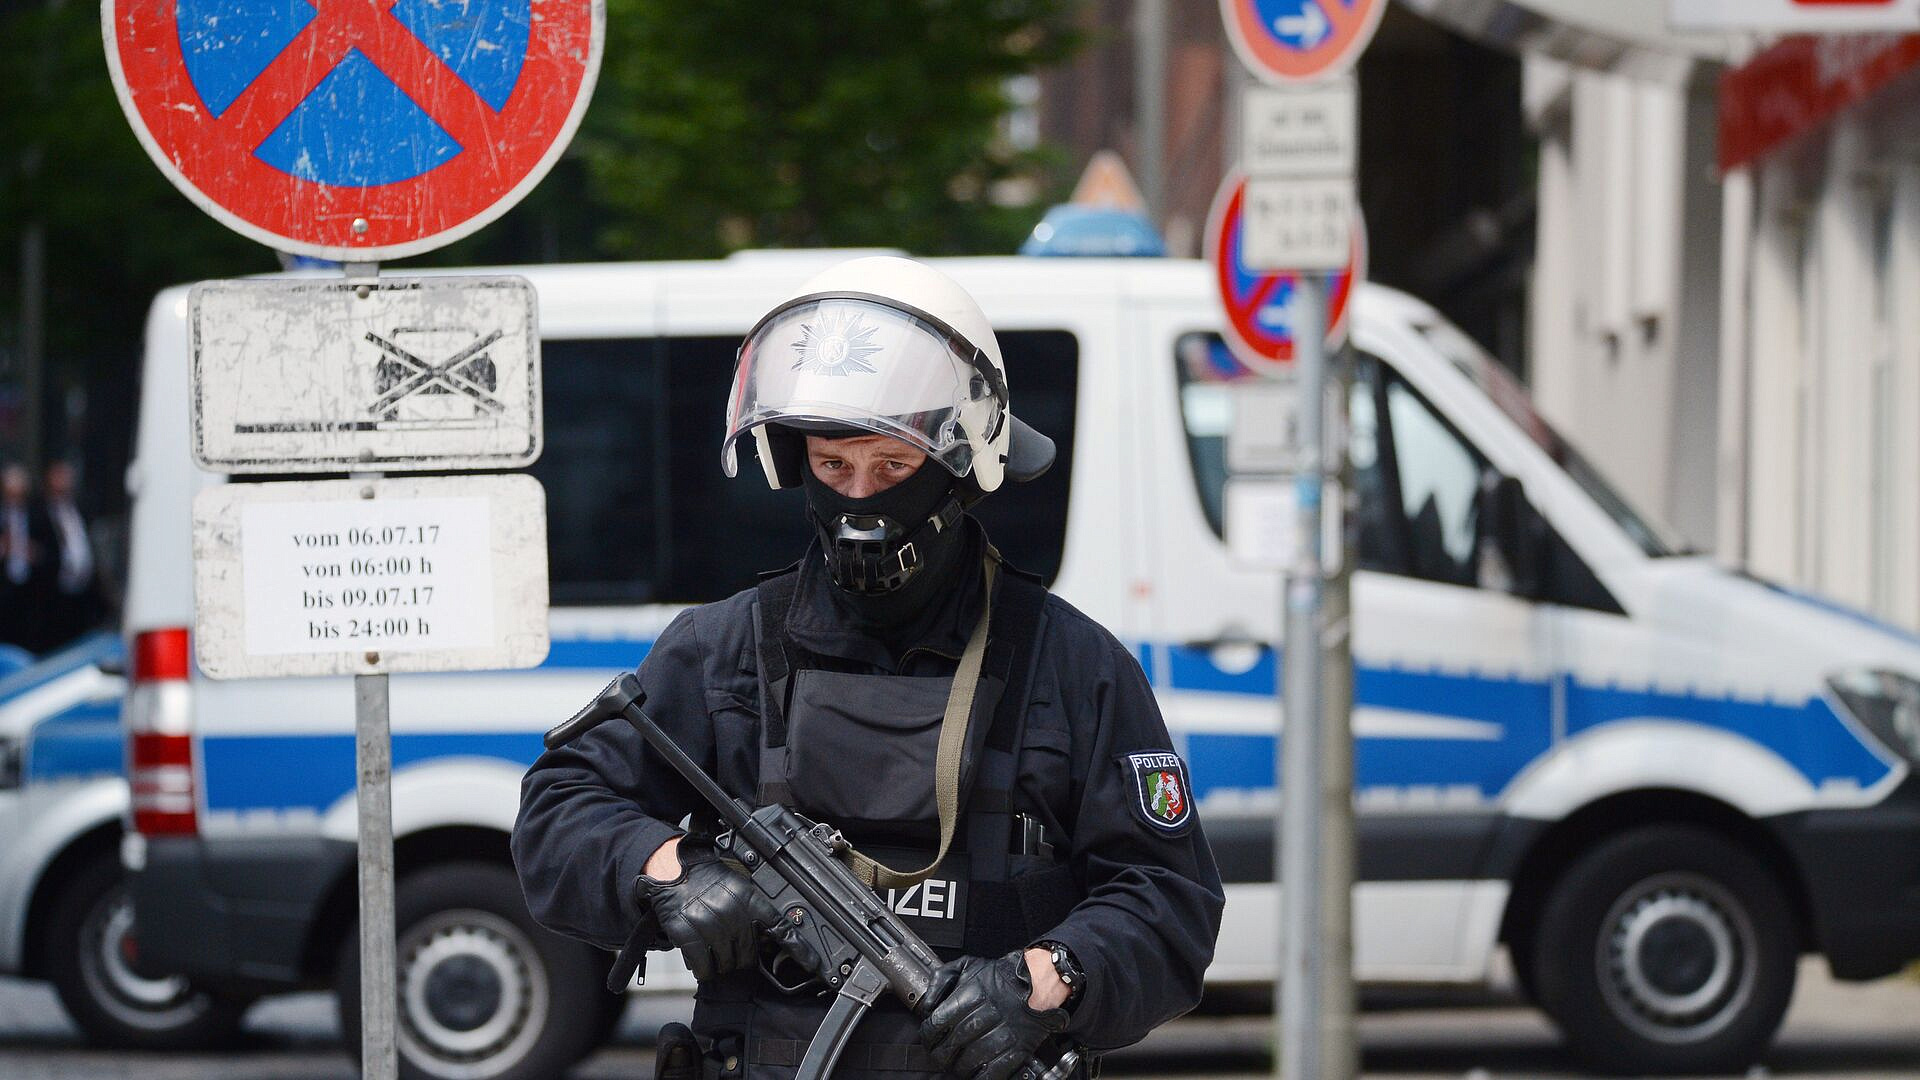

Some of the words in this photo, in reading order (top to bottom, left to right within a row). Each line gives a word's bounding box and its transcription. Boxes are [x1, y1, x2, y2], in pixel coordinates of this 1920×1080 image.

[293, 532, 340, 548] vom
[348, 525, 440, 546] 06.07.17
[302, 562, 342, 578] von
[350, 557, 412, 577] 06:00
[420, 556, 433, 575] h
[303, 590, 335, 609] bis
[342, 586, 434, 607] 09.07.17
[308, 620, 341, 640] bis
[348, 618, 410, 638] 24:00
[418, 617, 431, 636] h
[1134, 756, 1179, 769] POLIZEI
[887, 879, 957, 919] IZEI
